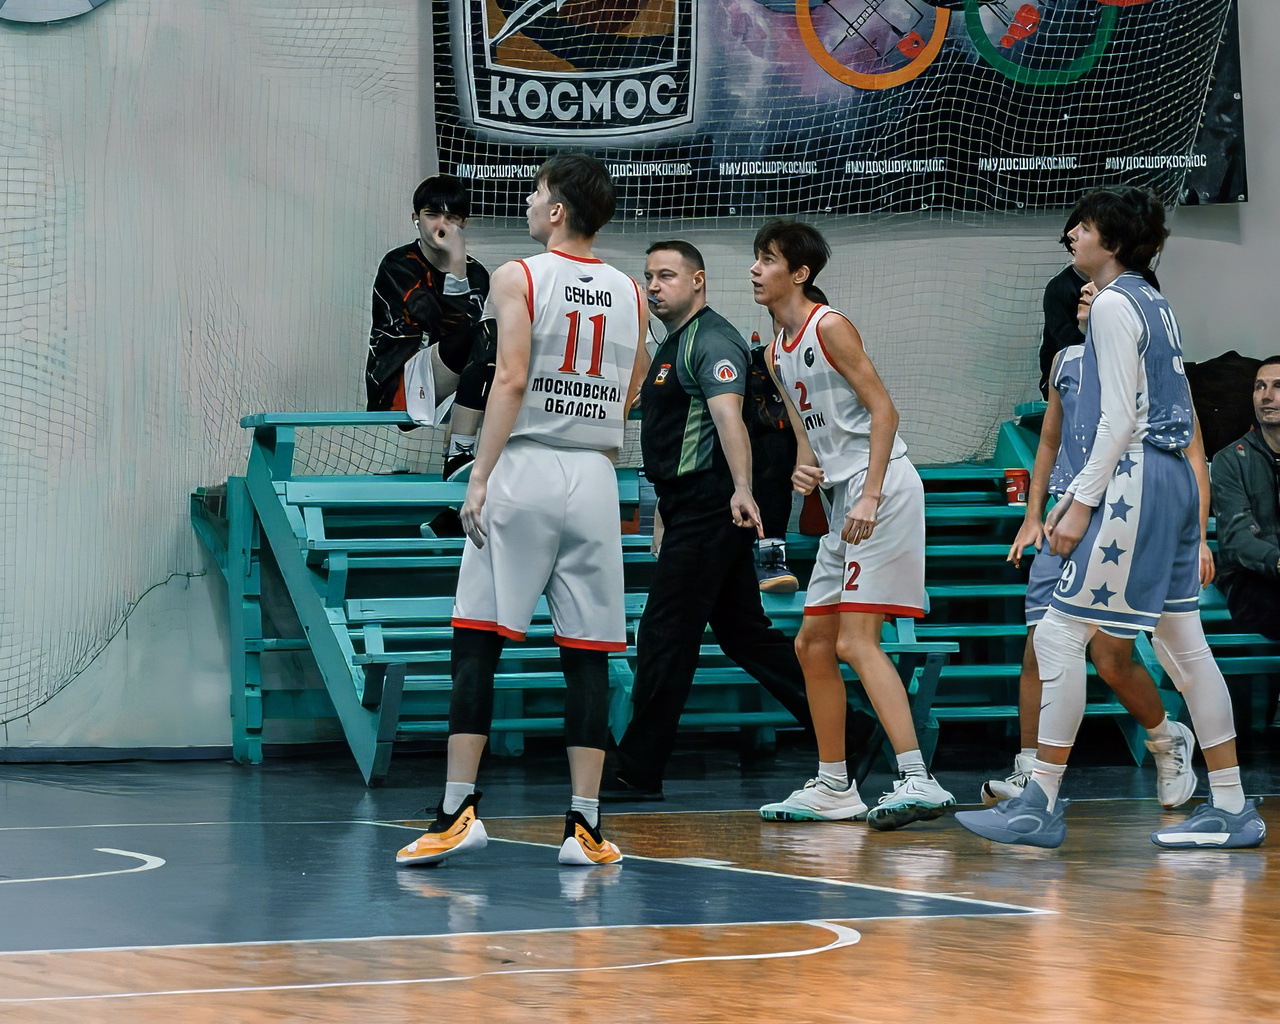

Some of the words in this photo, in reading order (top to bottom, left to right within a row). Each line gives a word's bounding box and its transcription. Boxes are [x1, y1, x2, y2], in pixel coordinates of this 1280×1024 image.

[489, 73, 677, 121] КОСМОС
[558, 309, 607, 379] 11
[544, 397, 607, 420] ОБЛАСТЬ
[795, 381, 813, 412] 2
[845, 561, 862, 591] 2
